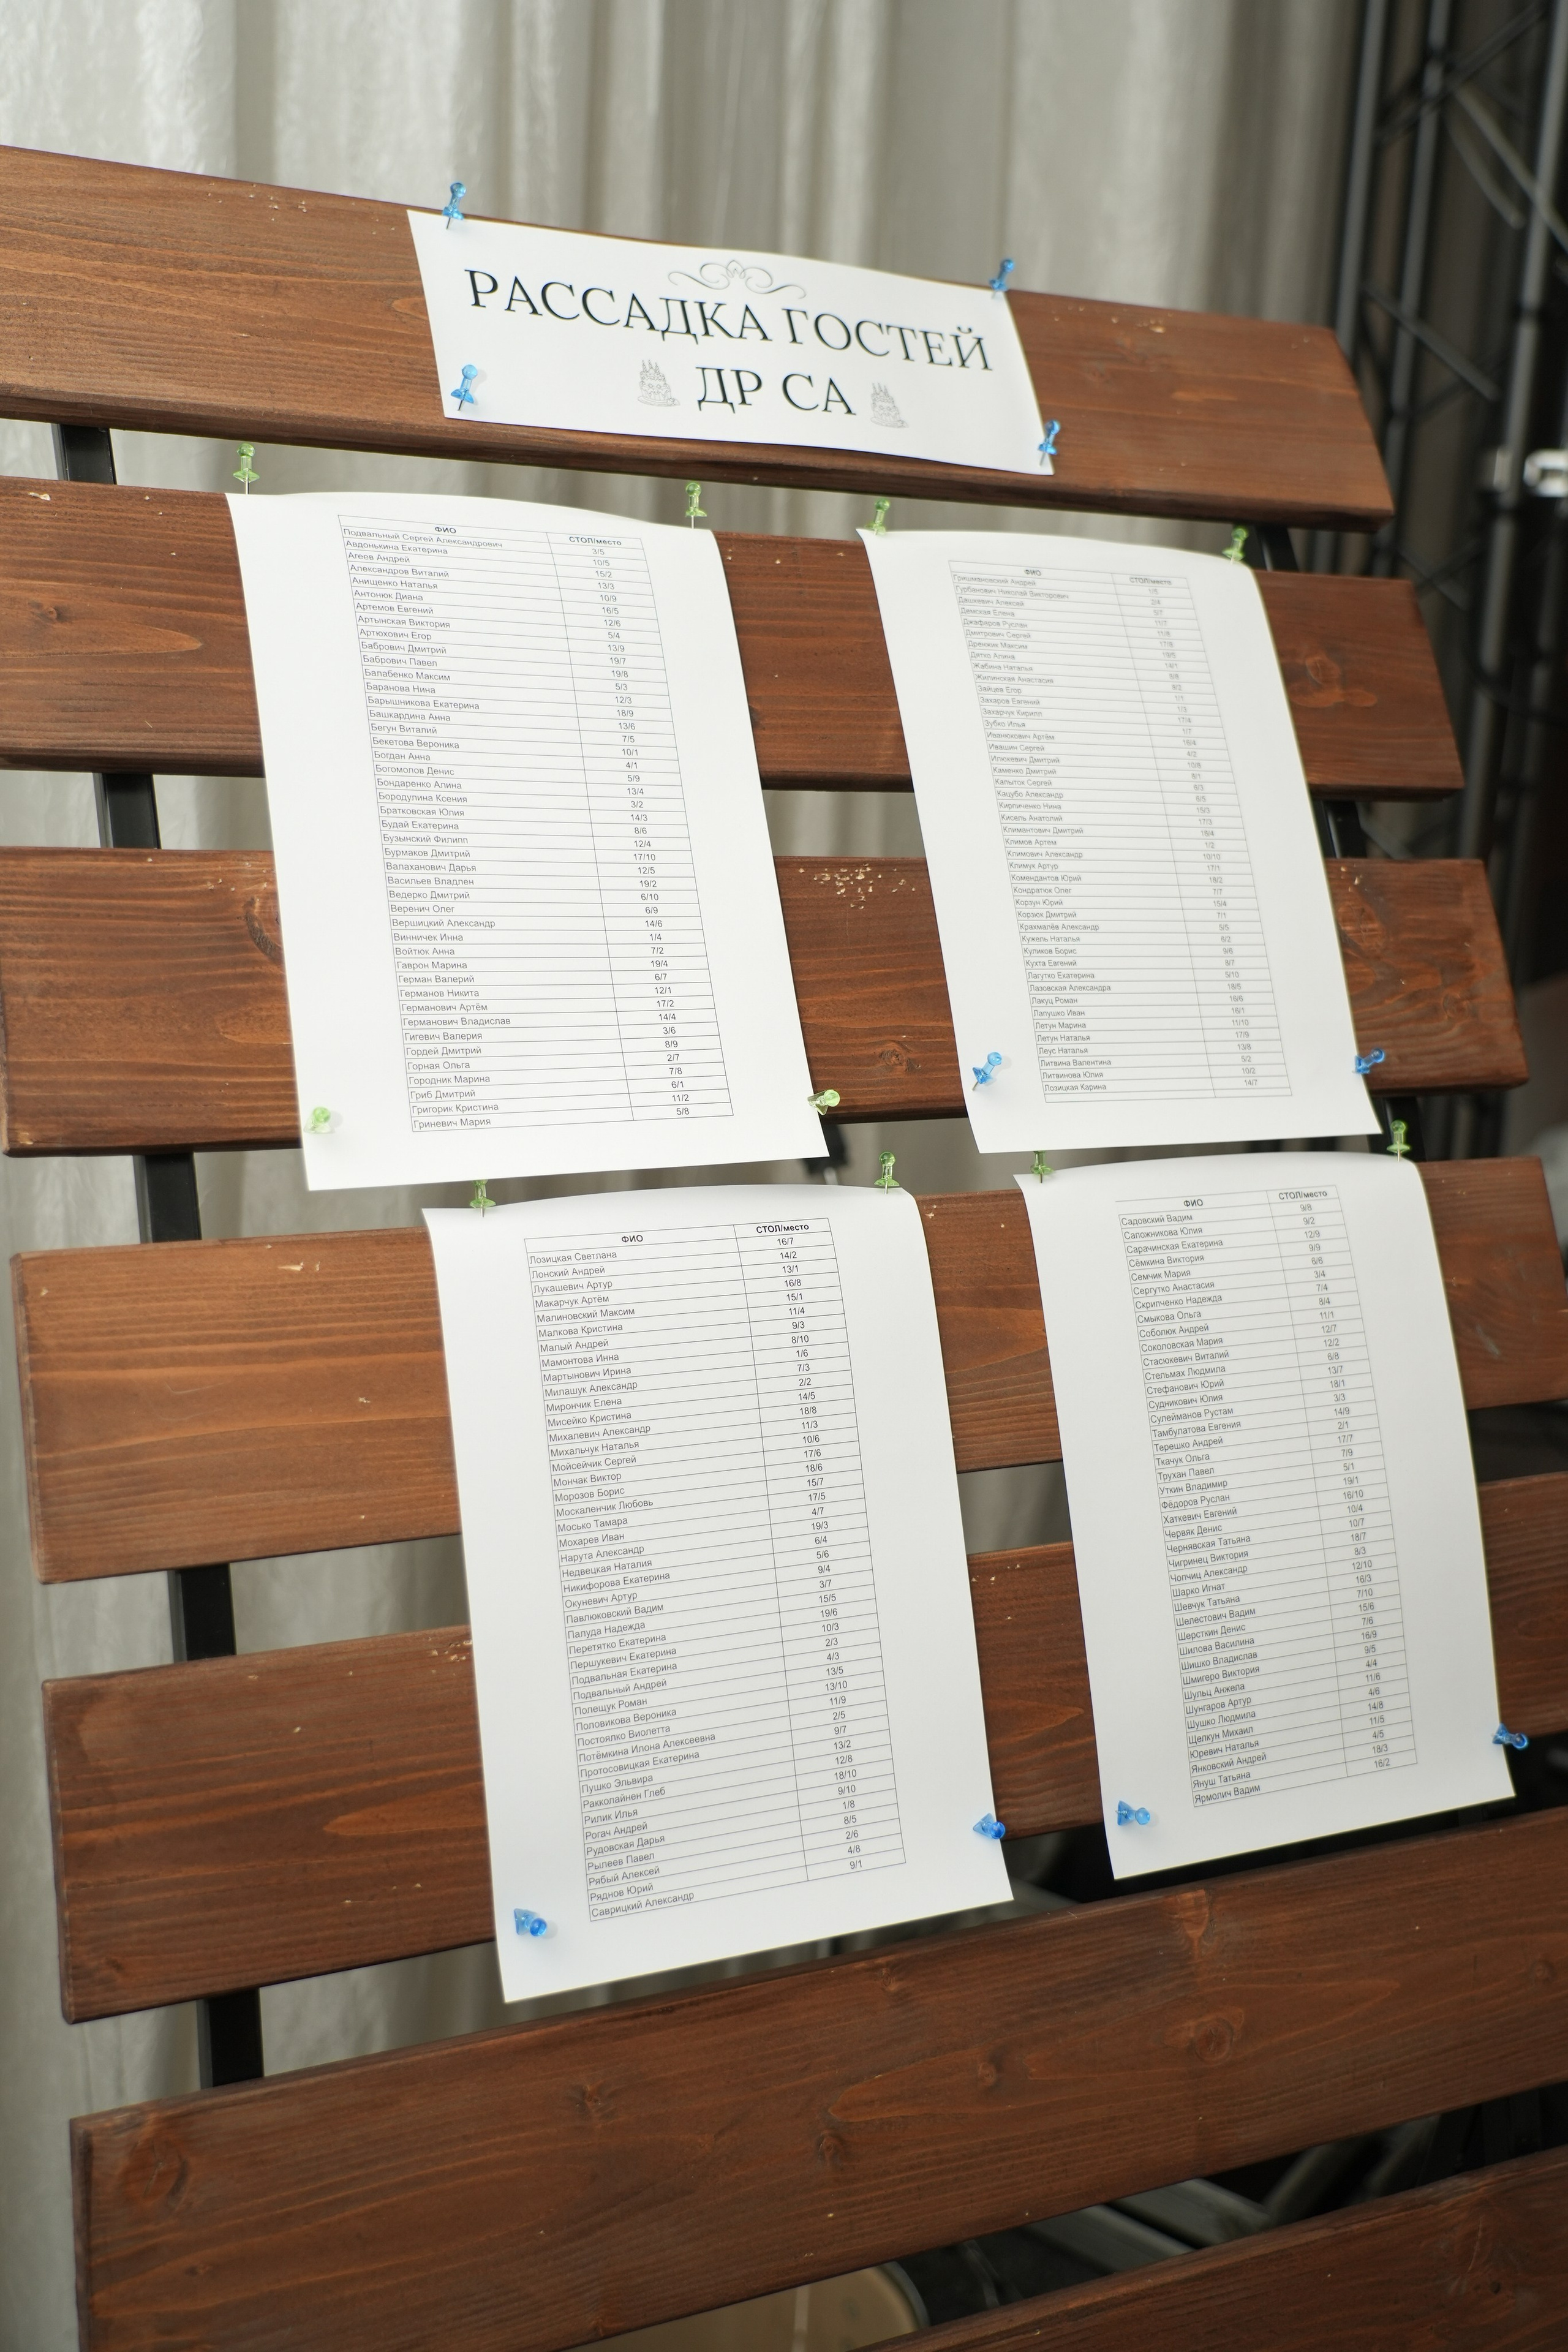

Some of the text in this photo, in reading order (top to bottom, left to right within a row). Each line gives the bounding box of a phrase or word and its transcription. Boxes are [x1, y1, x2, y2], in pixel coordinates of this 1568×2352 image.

[464, 269, 993, 371] РАССАДКА ГОСТЕЙ
[696, 366, 857, 415] ДР СА
[568, 536, 622, 546] СТОЛ/место
[347, 551, 612, 578] Агеев Андрей 15/2
[353, 589, 393, 599] Антонюк
[394, 592, 423, 601] Диана
[359, 628, 625, 652] Артюхович Егор 13/9
[364, 668, 628, 691] Балабенко Максим 5/3
[369, 709, 636, 730] Башкардина Анна 13/6
[374, 750, 405, 761] Богдан
[407, 752, 431, 761] Анна
[378, 791, 433, 802] Бородулина
[435, 794, 467, 802] Ксения
[998, 801, 1041, 810] Кирпиченко
[382, 833, 651, 848] Бузынский Филипп 12/4
[1034, 838, 1057, 846] Артем
[1044, 850, 1083, 859] Александр
[387, 876, 657, 888] Васильев Владлен 19/2
[1011, 873, 1059, 882] Комендантов
[1060, 874, 1082, 883] Юрий
[391, 918, 444, 929] Вершицкий
[447, 919, 496, 929] Александр
[1023, 947, 1053, 956] Куликов
[1054, 946, 1077, 956] Борис
[396, 960, 429, 970] Гаврон
[431, 960, 467, 970] Марина
[1031, 997, 1054, 1005] Лакуц
[1068, 984, 1111, 992] Александра
[402, 1017, 458, 1028] Германович
[460, 1017, 511, 1026] Владислав
[407, 1053, 679, 1071] Горная Ольга 2/7
[1038, 1046, 1056, 1055] Леус
[1183, 1190, 1327, 1207] ФИО СТОЛ/место
[620, 1224, 809, 1243] ФИО СТОЛ/место
[1126, 1229, 1320, 1254] Сарачинская Екатерина 12/9
[529, 1237, 793, 1264] Лозицкая Светлана 16/7
[535, 1278, 802, 1308] Макарчук Артём 16/8
[1133, 1269, 1325, 1295] Сергутко Анастасия 3/4
[540, 1320, 805, 1352] Малый Андрей 9/3
[1139, 1310, 1334, 1338] Соболюк Андрей 11/1
[1144, 1351, 1340, 1381] Стельмах Людмила 6/8
[544, 1363, 810, 1396] Милашук Александр 7/3
[1150, 1392, 1346, 1424] Сулейманов Рустам 3/3
[549, 1405, 817, 1442] Михалевич Александр 18/8
[1155, 1433, 1353, 1466] Ткачук Ольга 17/7
[553, 1448, 821, 1487] Мончак Виктор 17/6
[1161, 1475, 1359, 1509] Фёдоров Руслан 19/1
[557, 1491, 826, 1532] Мосько Тамара 17/5
[1166, 1517, 1365, 1553] Чернявская Татьяна 10/7
[562, 1535, 827, 1577] Недвецкая Наталия 6/4
[565, 1578, 832, 1624] Павлюковский Вадим 3/7
[1174, 1573, 1371, 1611] Шевчук Татьяна 16/3
[570, 1622, 839, 1670] Першукевич Екатерина 10/3
[1182, 1643, 1376, 1685] Шмигеро Виктория 9/5
[574, 1665, 843, 1716] Полещук Роман 13/5
[1189, 1714, 1385, 1759] Юревич Наталья 11/5
[582, 1754, 853, 1809] Ракколайнен Глеб 12/8
[588, 1829, 859, 1886] Рябый Алексей 2/6
